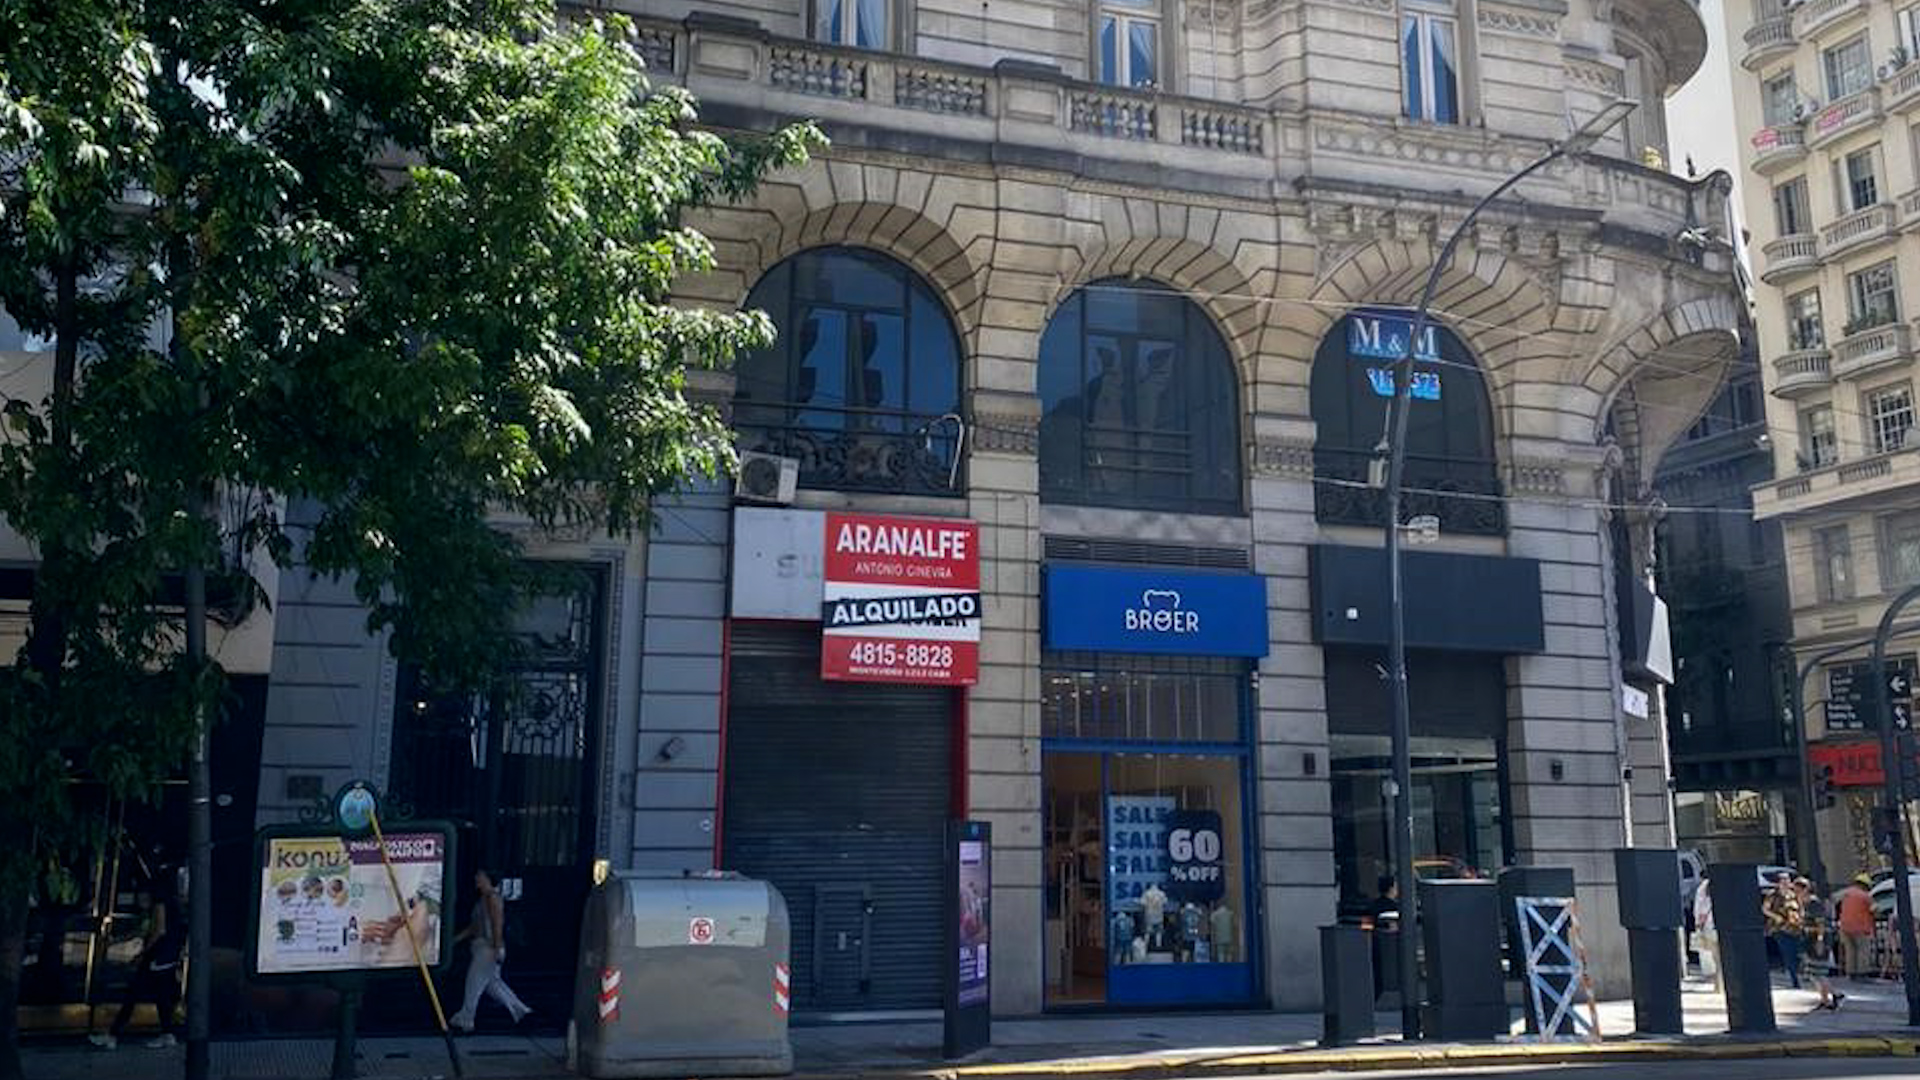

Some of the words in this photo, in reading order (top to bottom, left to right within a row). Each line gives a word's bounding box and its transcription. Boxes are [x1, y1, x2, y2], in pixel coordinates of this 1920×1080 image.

[1354, 317, 1381, 350] M
[1388, 334, 1403, 352] &
[836, 524, 966, 560] ARANALFE
[855, 562, 903, 578] ANTONIO
[832, 596, 976, 625] ALQUILADO
[1125, 608, 1200, 633] BROER
[850, 641, 954, 668] 4815-8828
[1114, 806, 1168, 824] SALE
[1168, 828, 1220, 863] 60
